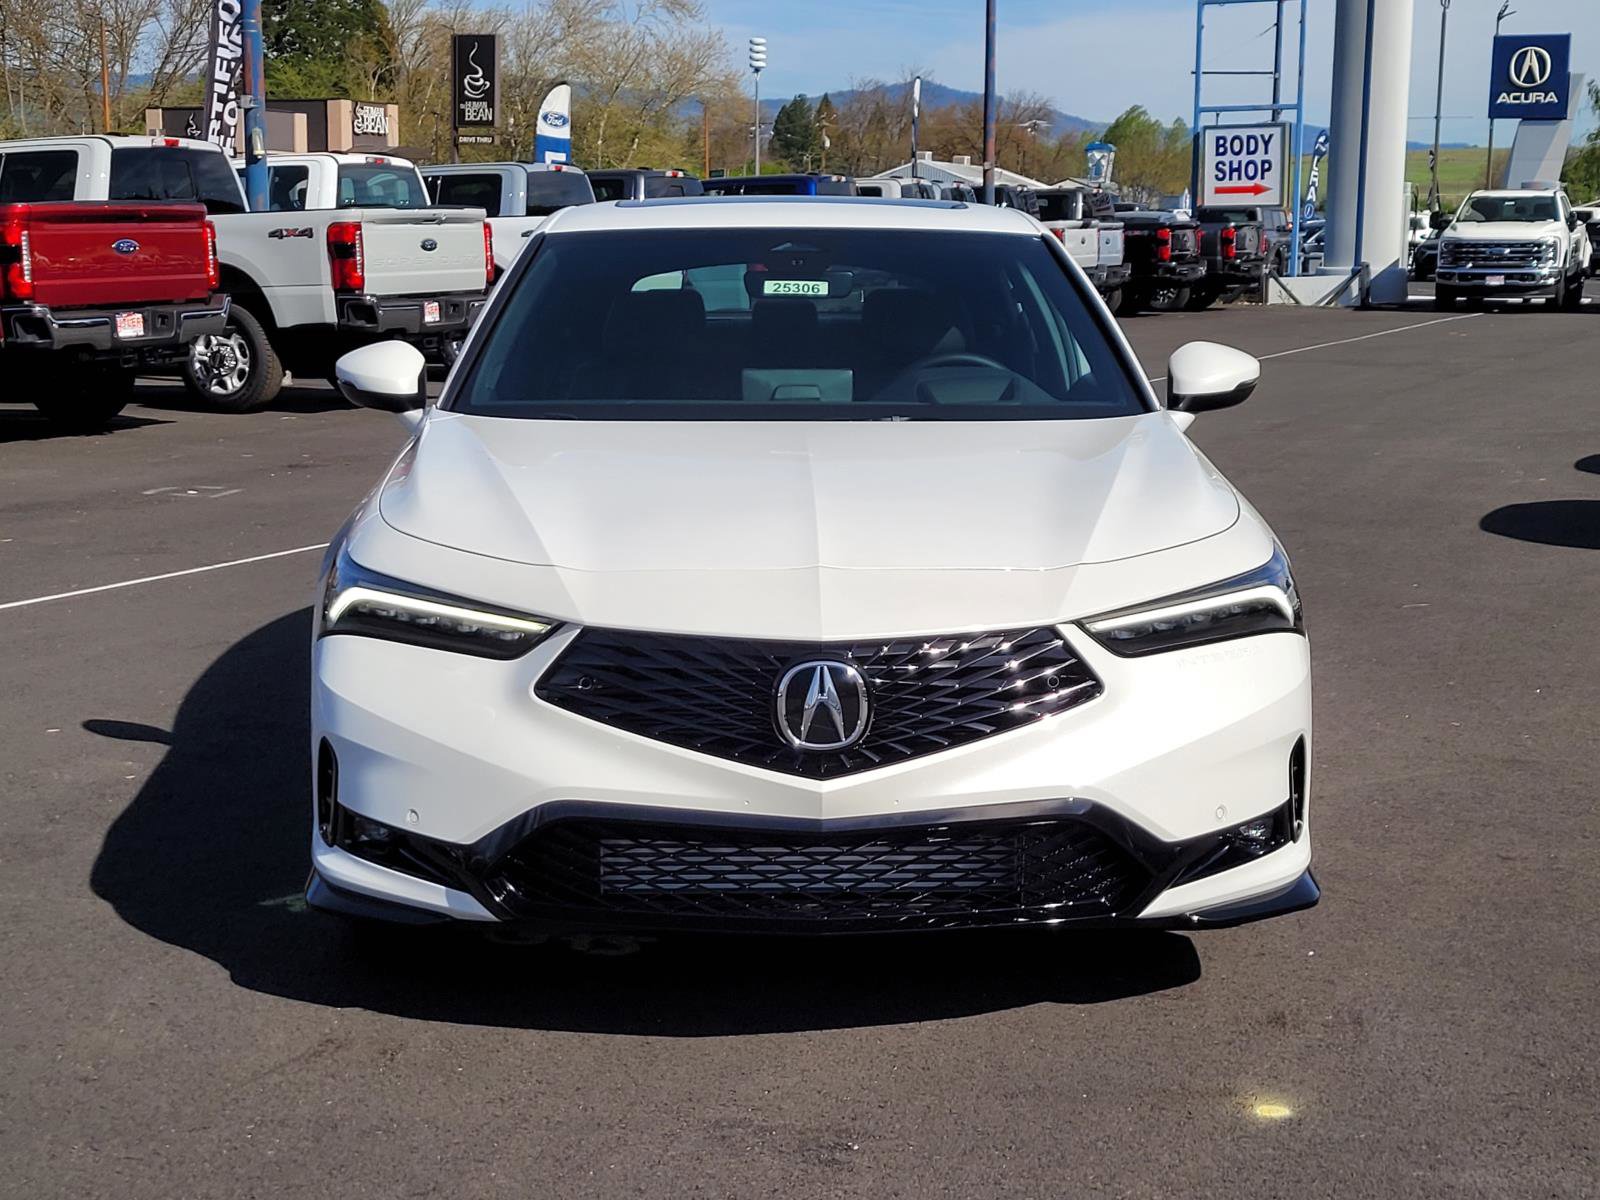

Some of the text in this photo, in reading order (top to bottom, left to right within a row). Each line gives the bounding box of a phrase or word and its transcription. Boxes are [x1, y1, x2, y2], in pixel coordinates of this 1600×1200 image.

[208, 0, 241, 144] RTIFIED
[1496, 92, 1559, 104] ACURA
[465, 107, 493, 121] BEAN
[363, 115, 389, 134] BEAN
[1215, 133, 1274, 156] BODY
[1214, 159, 1273, 182] SHOP
[772, 282, 821, 294] 25306
